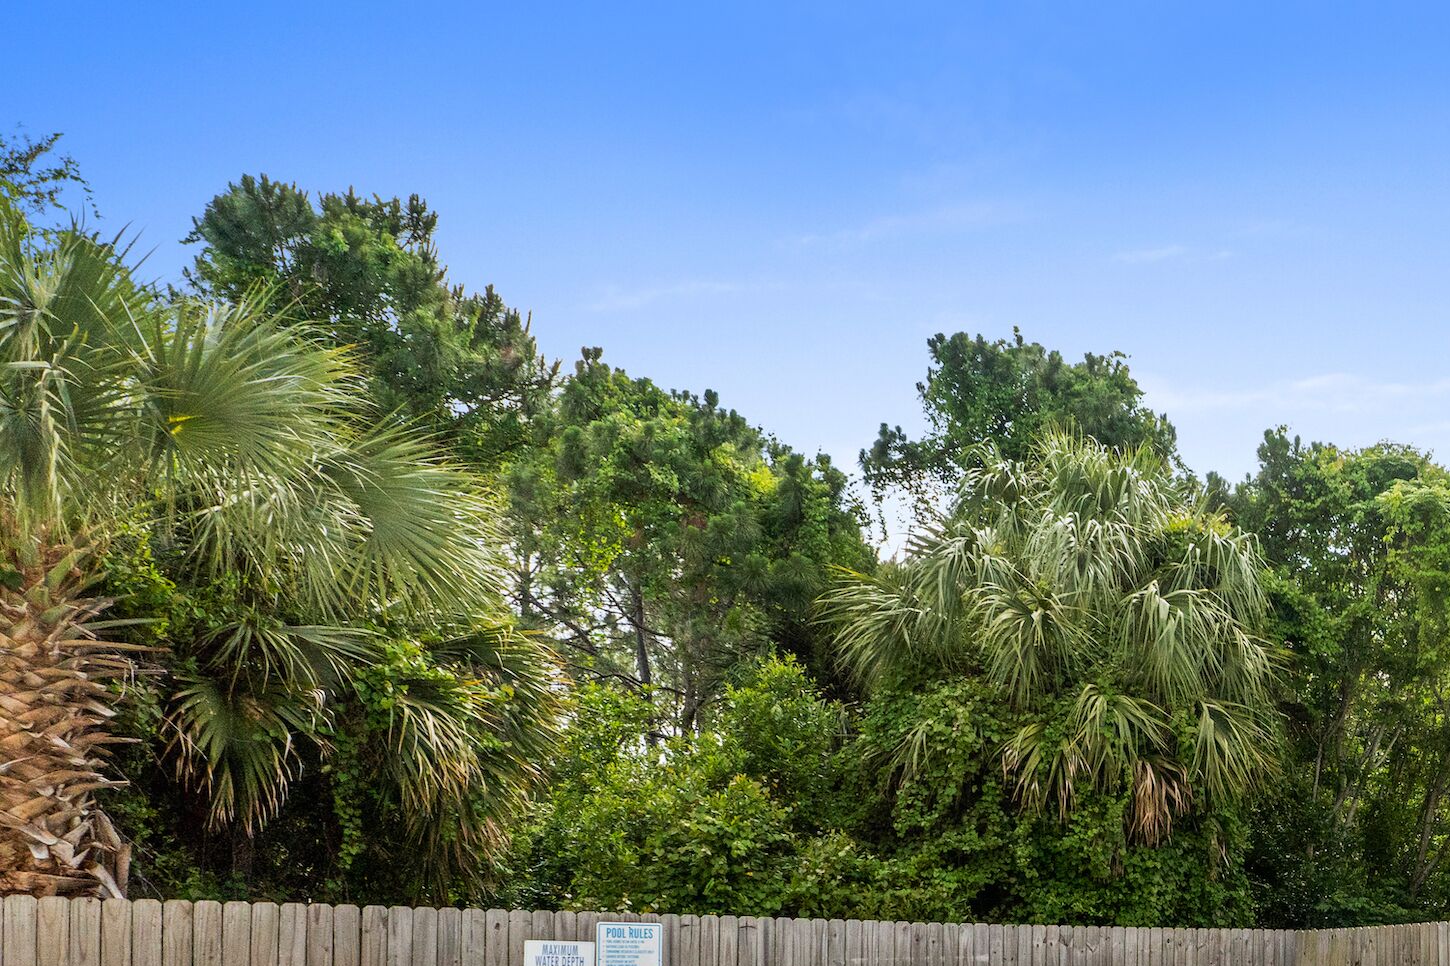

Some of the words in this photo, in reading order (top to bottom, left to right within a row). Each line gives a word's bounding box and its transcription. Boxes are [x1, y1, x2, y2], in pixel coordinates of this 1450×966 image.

[606, 928, 626, 938] POOL
[629, 928, 653, 939] RULES
[542, 944, 578, 955] MAXIMUM
[535, 956, 559, 966] WATER
[562, 956, 585, 966] DEPTH
